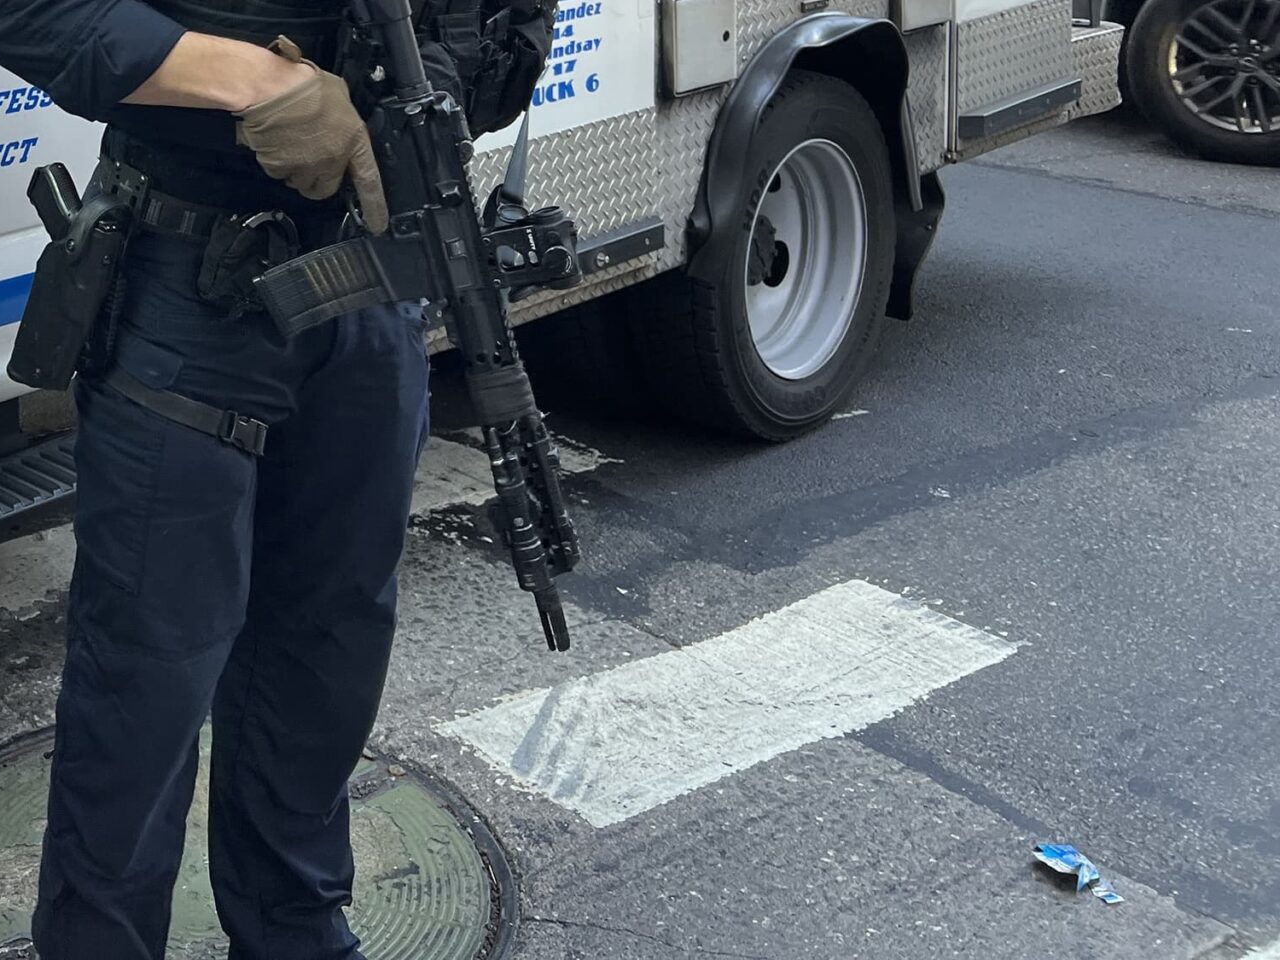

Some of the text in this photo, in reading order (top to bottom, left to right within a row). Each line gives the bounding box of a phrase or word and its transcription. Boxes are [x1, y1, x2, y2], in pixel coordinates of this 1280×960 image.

[553, 60, 577, 75] 17
[532, 73, 600, 106] UCK 6
